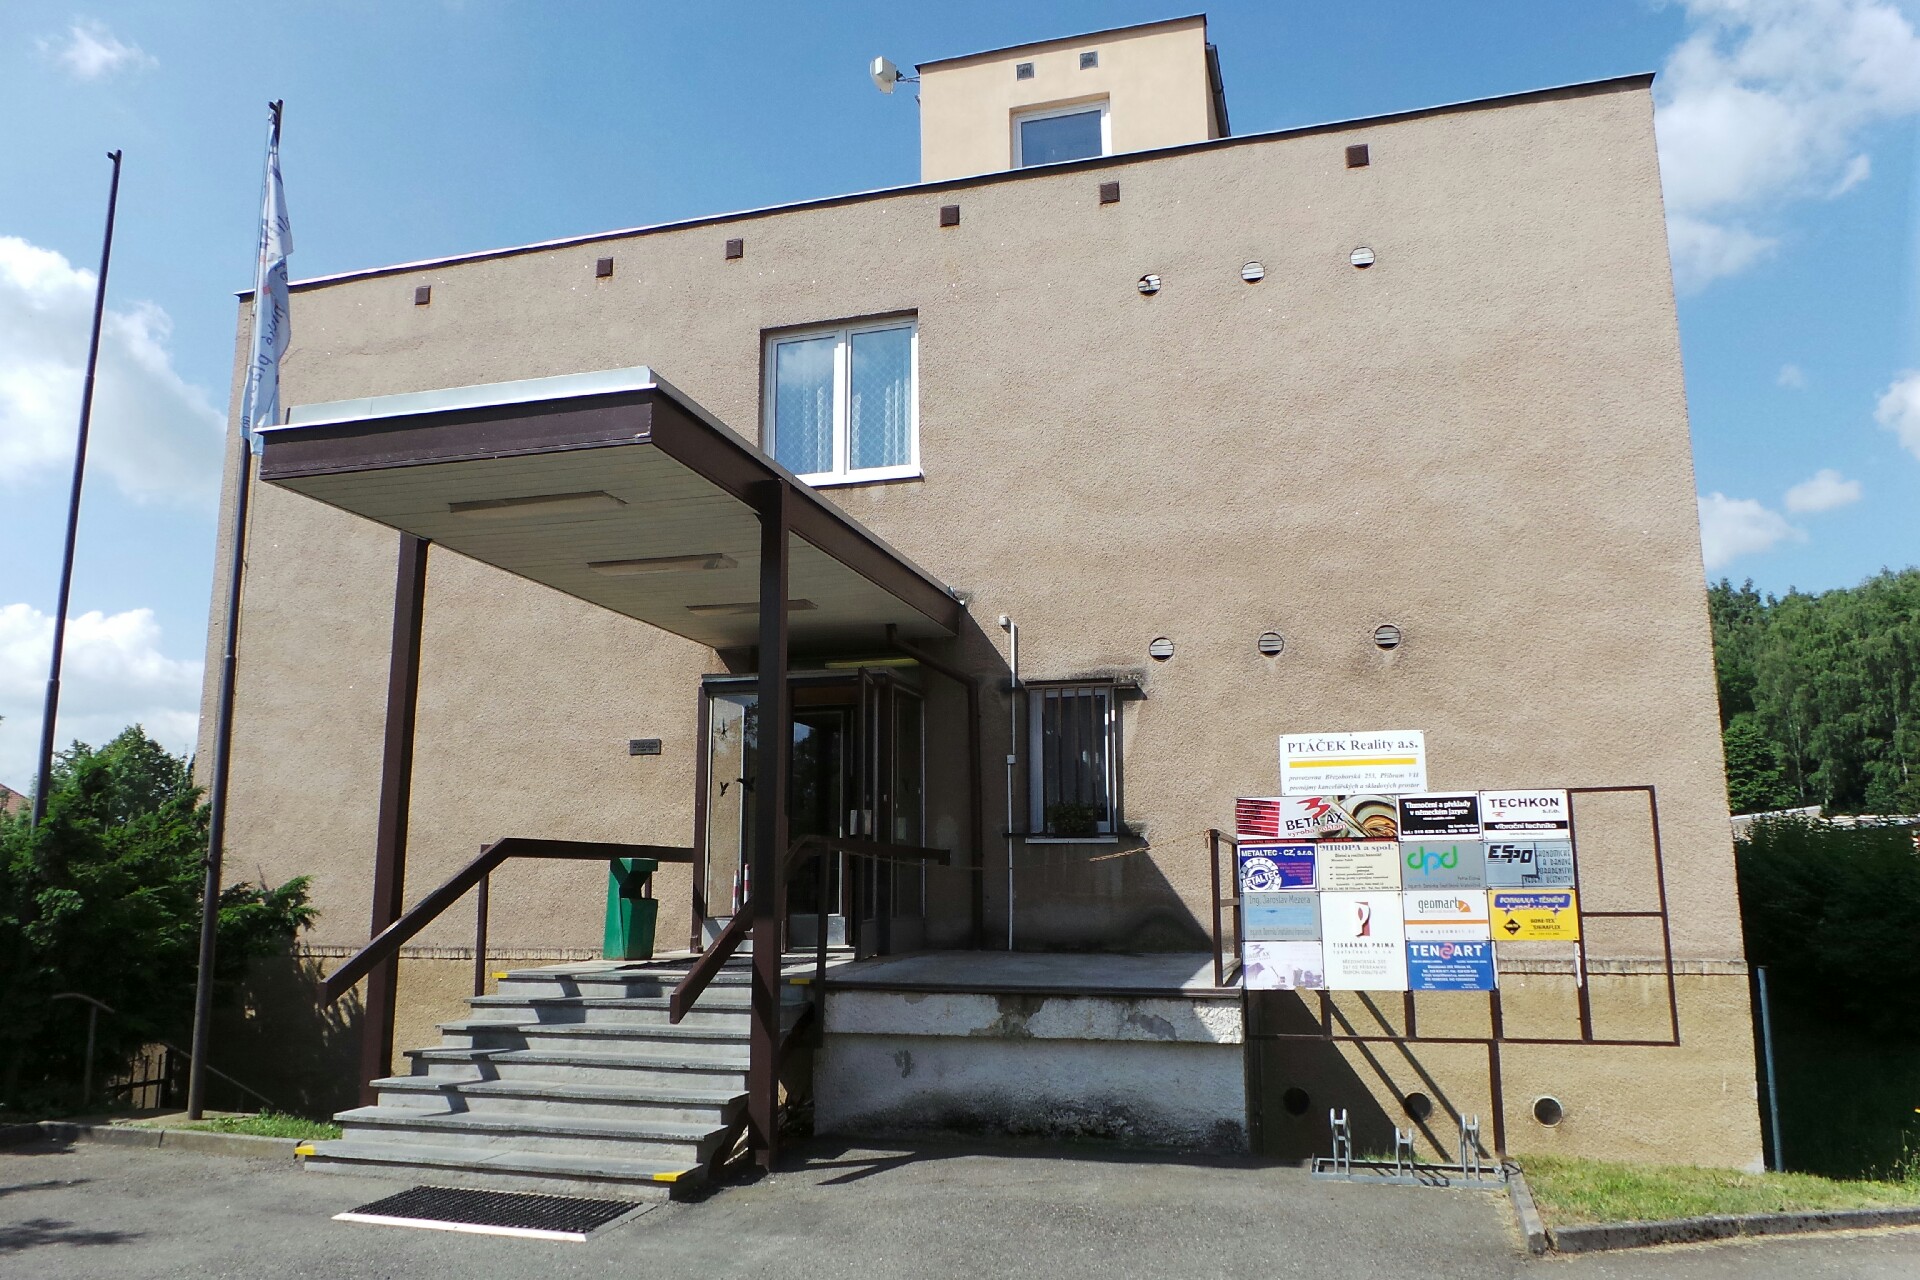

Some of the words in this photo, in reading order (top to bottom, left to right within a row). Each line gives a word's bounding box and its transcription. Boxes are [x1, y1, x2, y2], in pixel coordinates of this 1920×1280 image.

[1287, 738, 1347, 753] PTÁČEK
[1350, 738, 1394, 752] Reality
[1397, 740, 1419, 750] a.s.
[1380, 771, 1405, 779] Příbram
[1288, 783, 1317, 792] pronájmy
[1364, 781, 1397, 791] skladových
[1397, 782, 1420, 790] prostor
[1404, 800, 1438, 809] Tlumočení
[1443, 799, 1471, 809] překlady
[1488, 797, 1560, 809] TECHKON
[1285, 815, 1321, 831] BETA
[1326, 812, 1345, 824] AX
[1241, 849, 1278, 857] METALTEC
[1319, 844, 1361, 852] MIROPA
[1371, 843, 1395, 853] spol.
[1407, 845, 1459, 876] dpd
[1249, 895, 1262, 906] Ing.
[1262, 894, 1288, 905] Jaroslav
[1418, 896, 1459, 914] geomart
